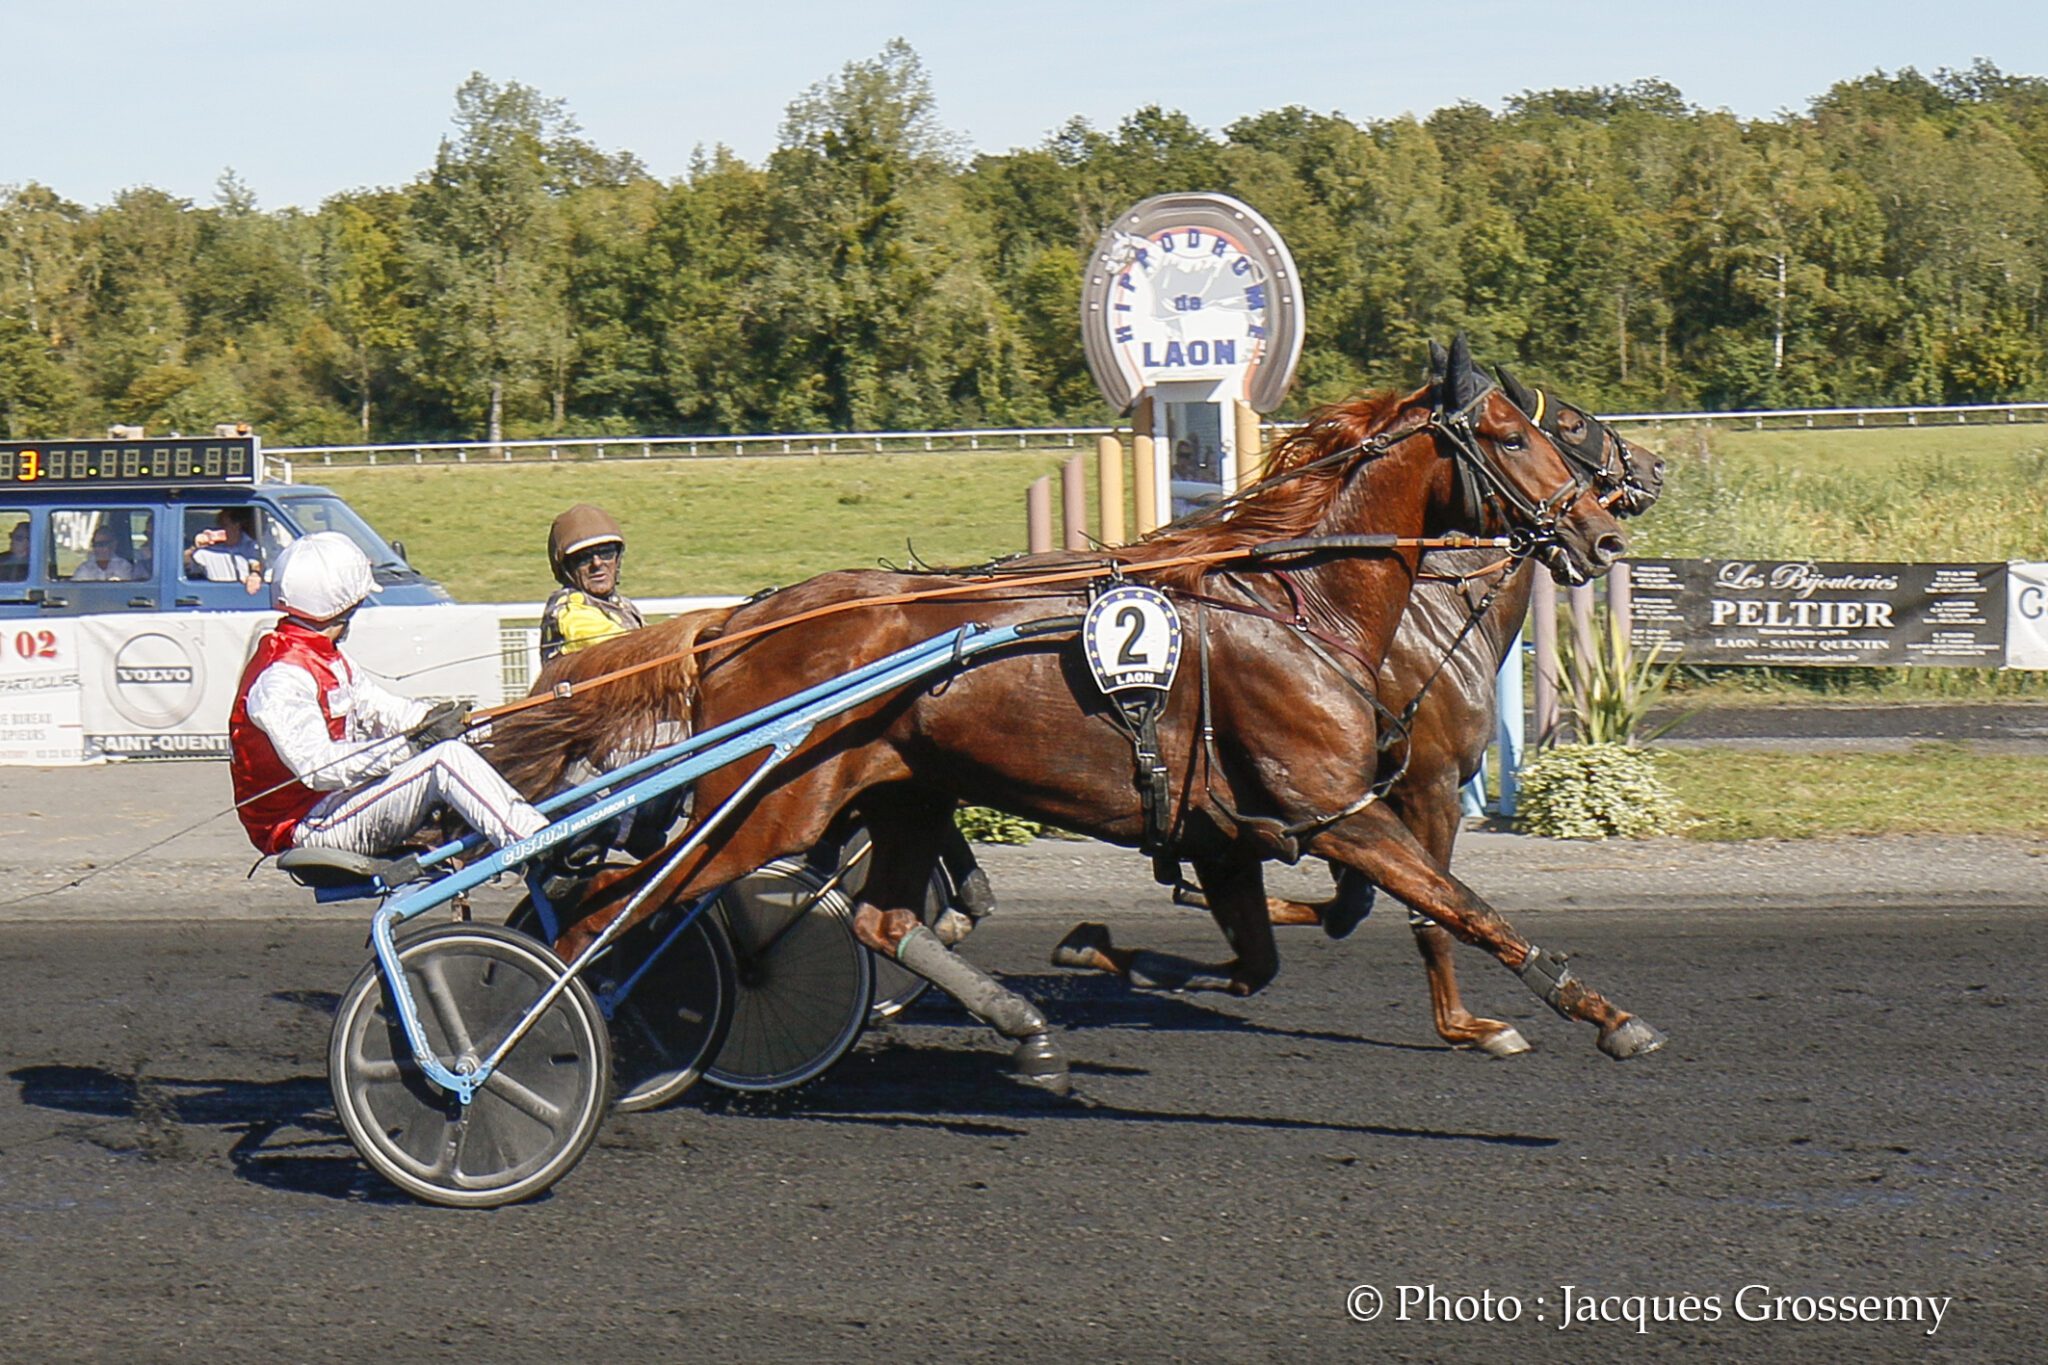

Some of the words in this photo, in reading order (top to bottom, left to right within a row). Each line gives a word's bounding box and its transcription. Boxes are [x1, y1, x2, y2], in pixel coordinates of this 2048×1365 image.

[1174, 295, 1202, 312] de
[1143, 340, 1236, 368] LAON
[1714, 562, 1765, 590] Les
[1769, 562, 1899, 600] Bijouteries
[1709, 600, 1896, 628] PELTIER
[15, 630, 57, 659] 02
[1115, 606, 1149, 666] 2
[1714, 637, 1760, 649] LAON
[1769, 639, 1817, 651] SAINT
[1818, 639, 1891, 652] QUENTIN
[117, 668, 190, 681] VOLVO
[1115, 672, 1155, 685] LAON
[502, 822, 568, 866] CUSTOM
